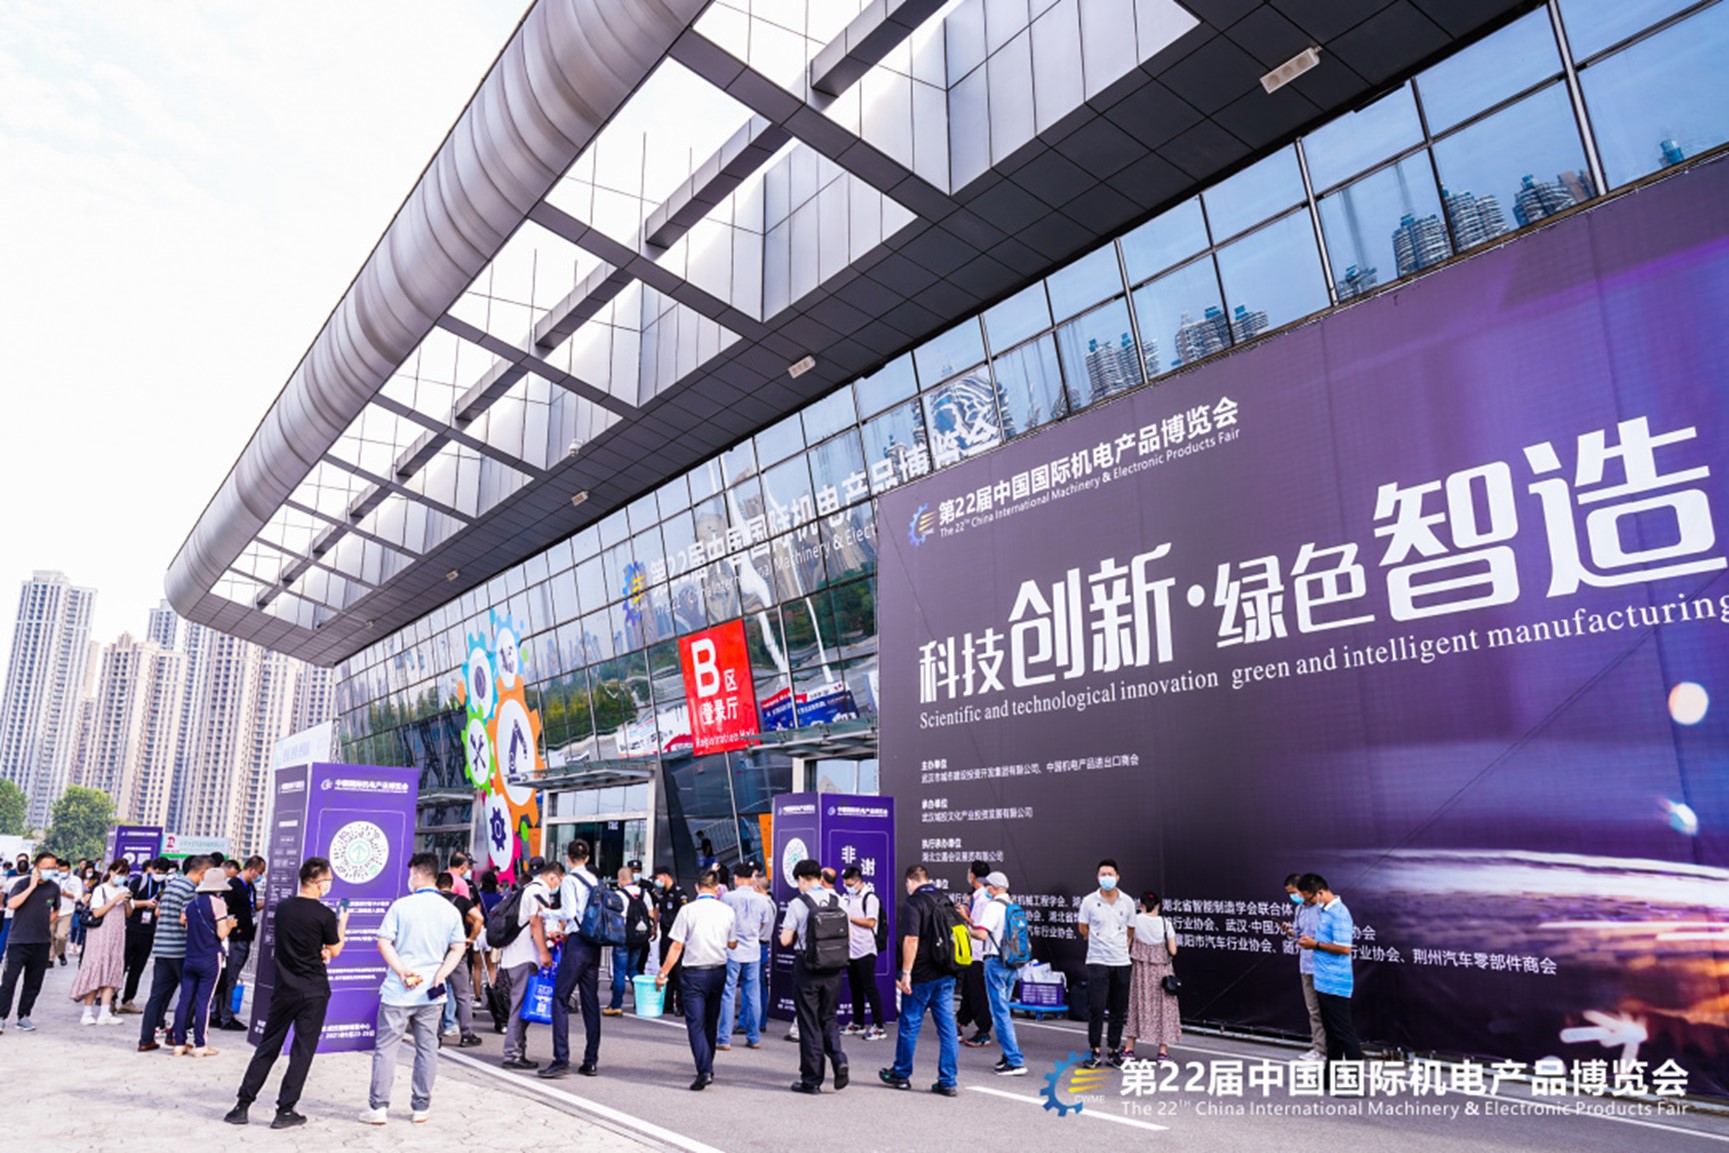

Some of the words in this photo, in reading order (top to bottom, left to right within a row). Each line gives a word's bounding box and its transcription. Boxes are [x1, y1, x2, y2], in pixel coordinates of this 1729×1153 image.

[938, 396, 1238, 526] 第22届中国国际机电产品博览会
[940, 525, 954, 538] The
[971, 513, 994, 528] China
[995, 493, 1050, 520] International
[1051, 476, 1101, 500] Machinery
[1102, 471, 1112, 483] &
[1113, 454, 1165, 480] Electronic
[1166, 437, 1216, 462] Products
[1218, 427, 1241, 445] Fair
[833, 536, 844, 550] &
[918, 415, 1728, 703] 科技创新·绿色智造
[920, 705, 981, 729] Scientific
[985, 699, 1009, 718] and
[1012, 683, 1116, 714] technological
[1120, 671, 1218, 699] innovation
[1232, 658, 1290, 690] green
[1296, 648, 1337, 674] and
[1343, 629, 1480, 668] intelligent
[1165, 916, 1287, 935] 行业协会、武汉·中国
